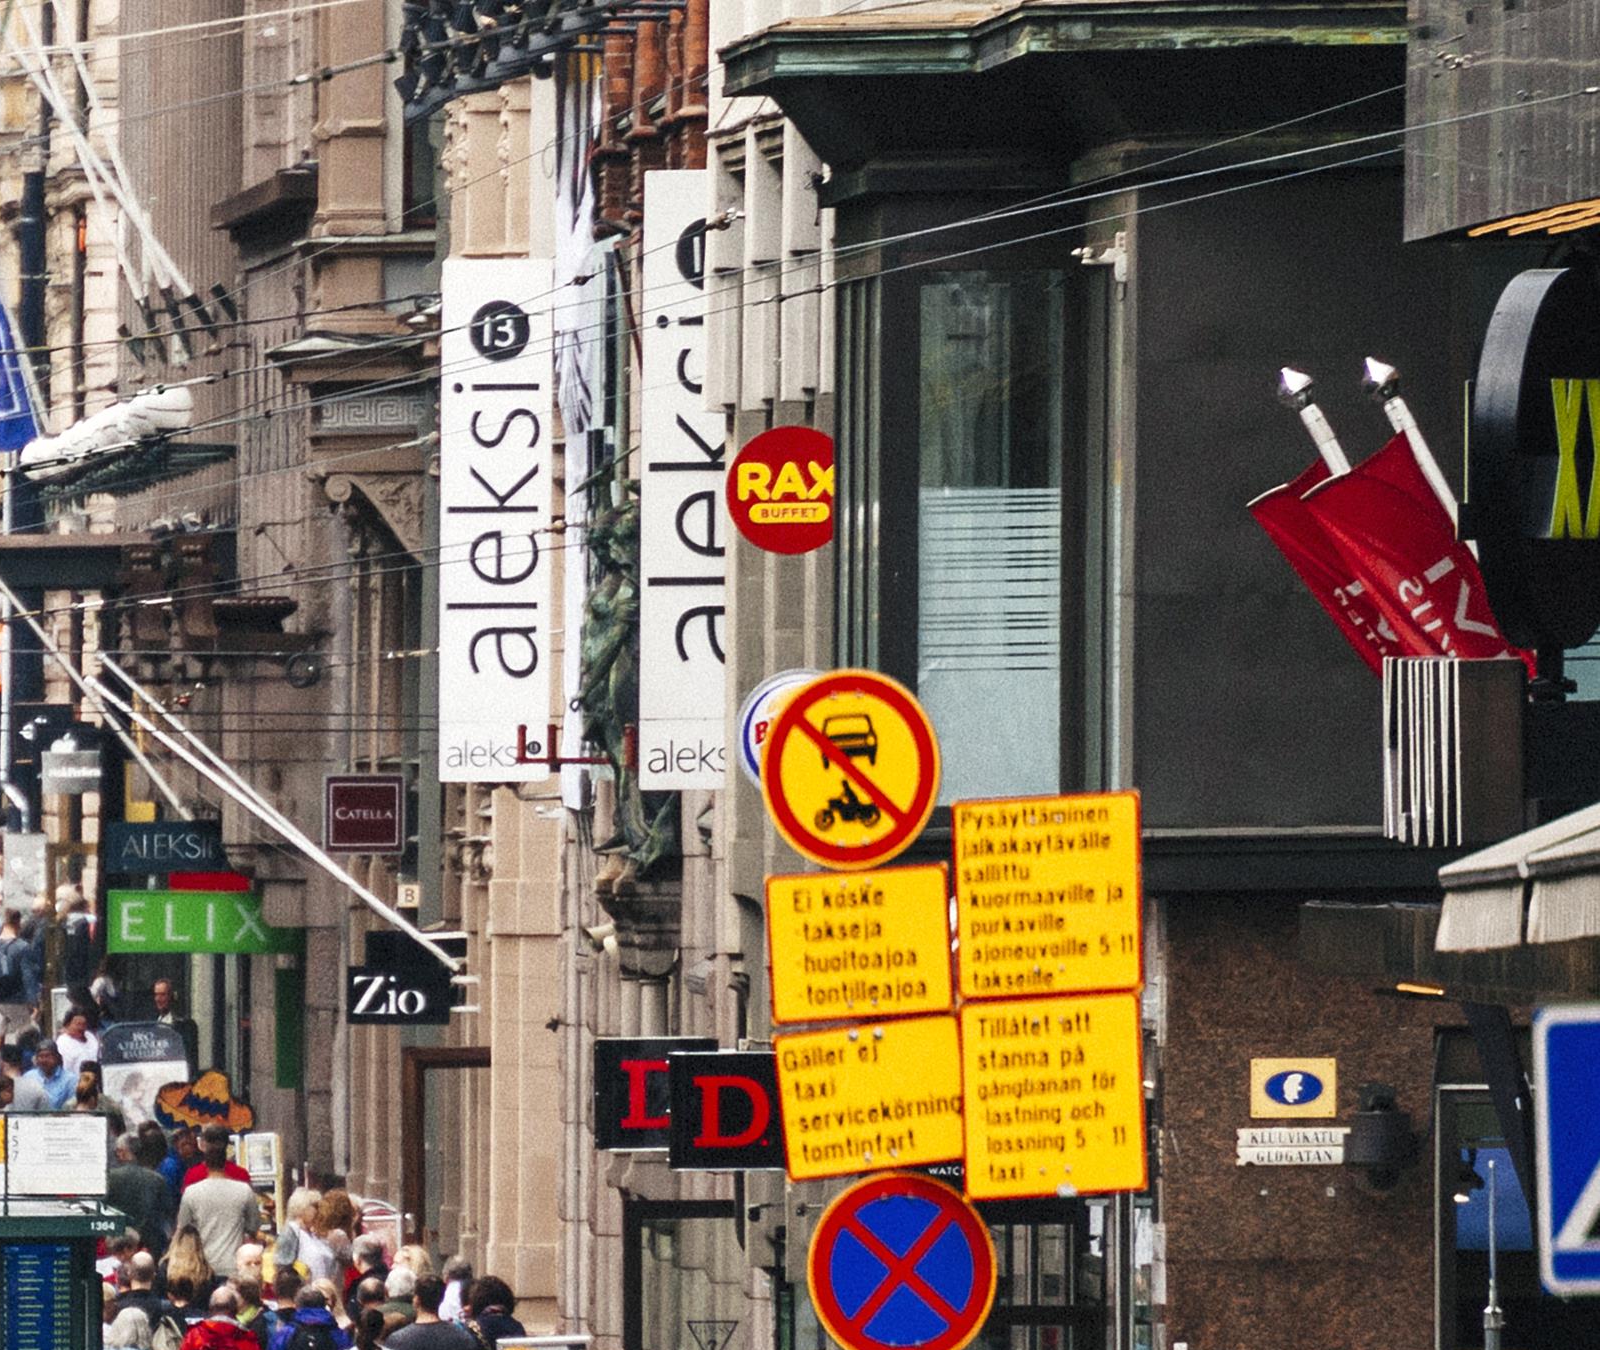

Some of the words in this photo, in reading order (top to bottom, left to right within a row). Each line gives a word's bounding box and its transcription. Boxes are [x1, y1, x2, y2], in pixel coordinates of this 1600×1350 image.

[737, 462, 833, 502] RAX
[760, 505, 819, 520] BUFFET
[446, 381, 540, 680] aleksi
[792, 888, 812, 913] Ei
[1107, 882, 1124, 905] ja
[352, 976, 426, 1015] Zio
[978, 1014, 1050, 1038] Tillåtet
[858, 1040, 880, 1063] ej
[978, 1049, 1050, 1071] stanna
[1060, 1045, 1085, 1069] på
[1070, 1101, 1106, 1122] och
